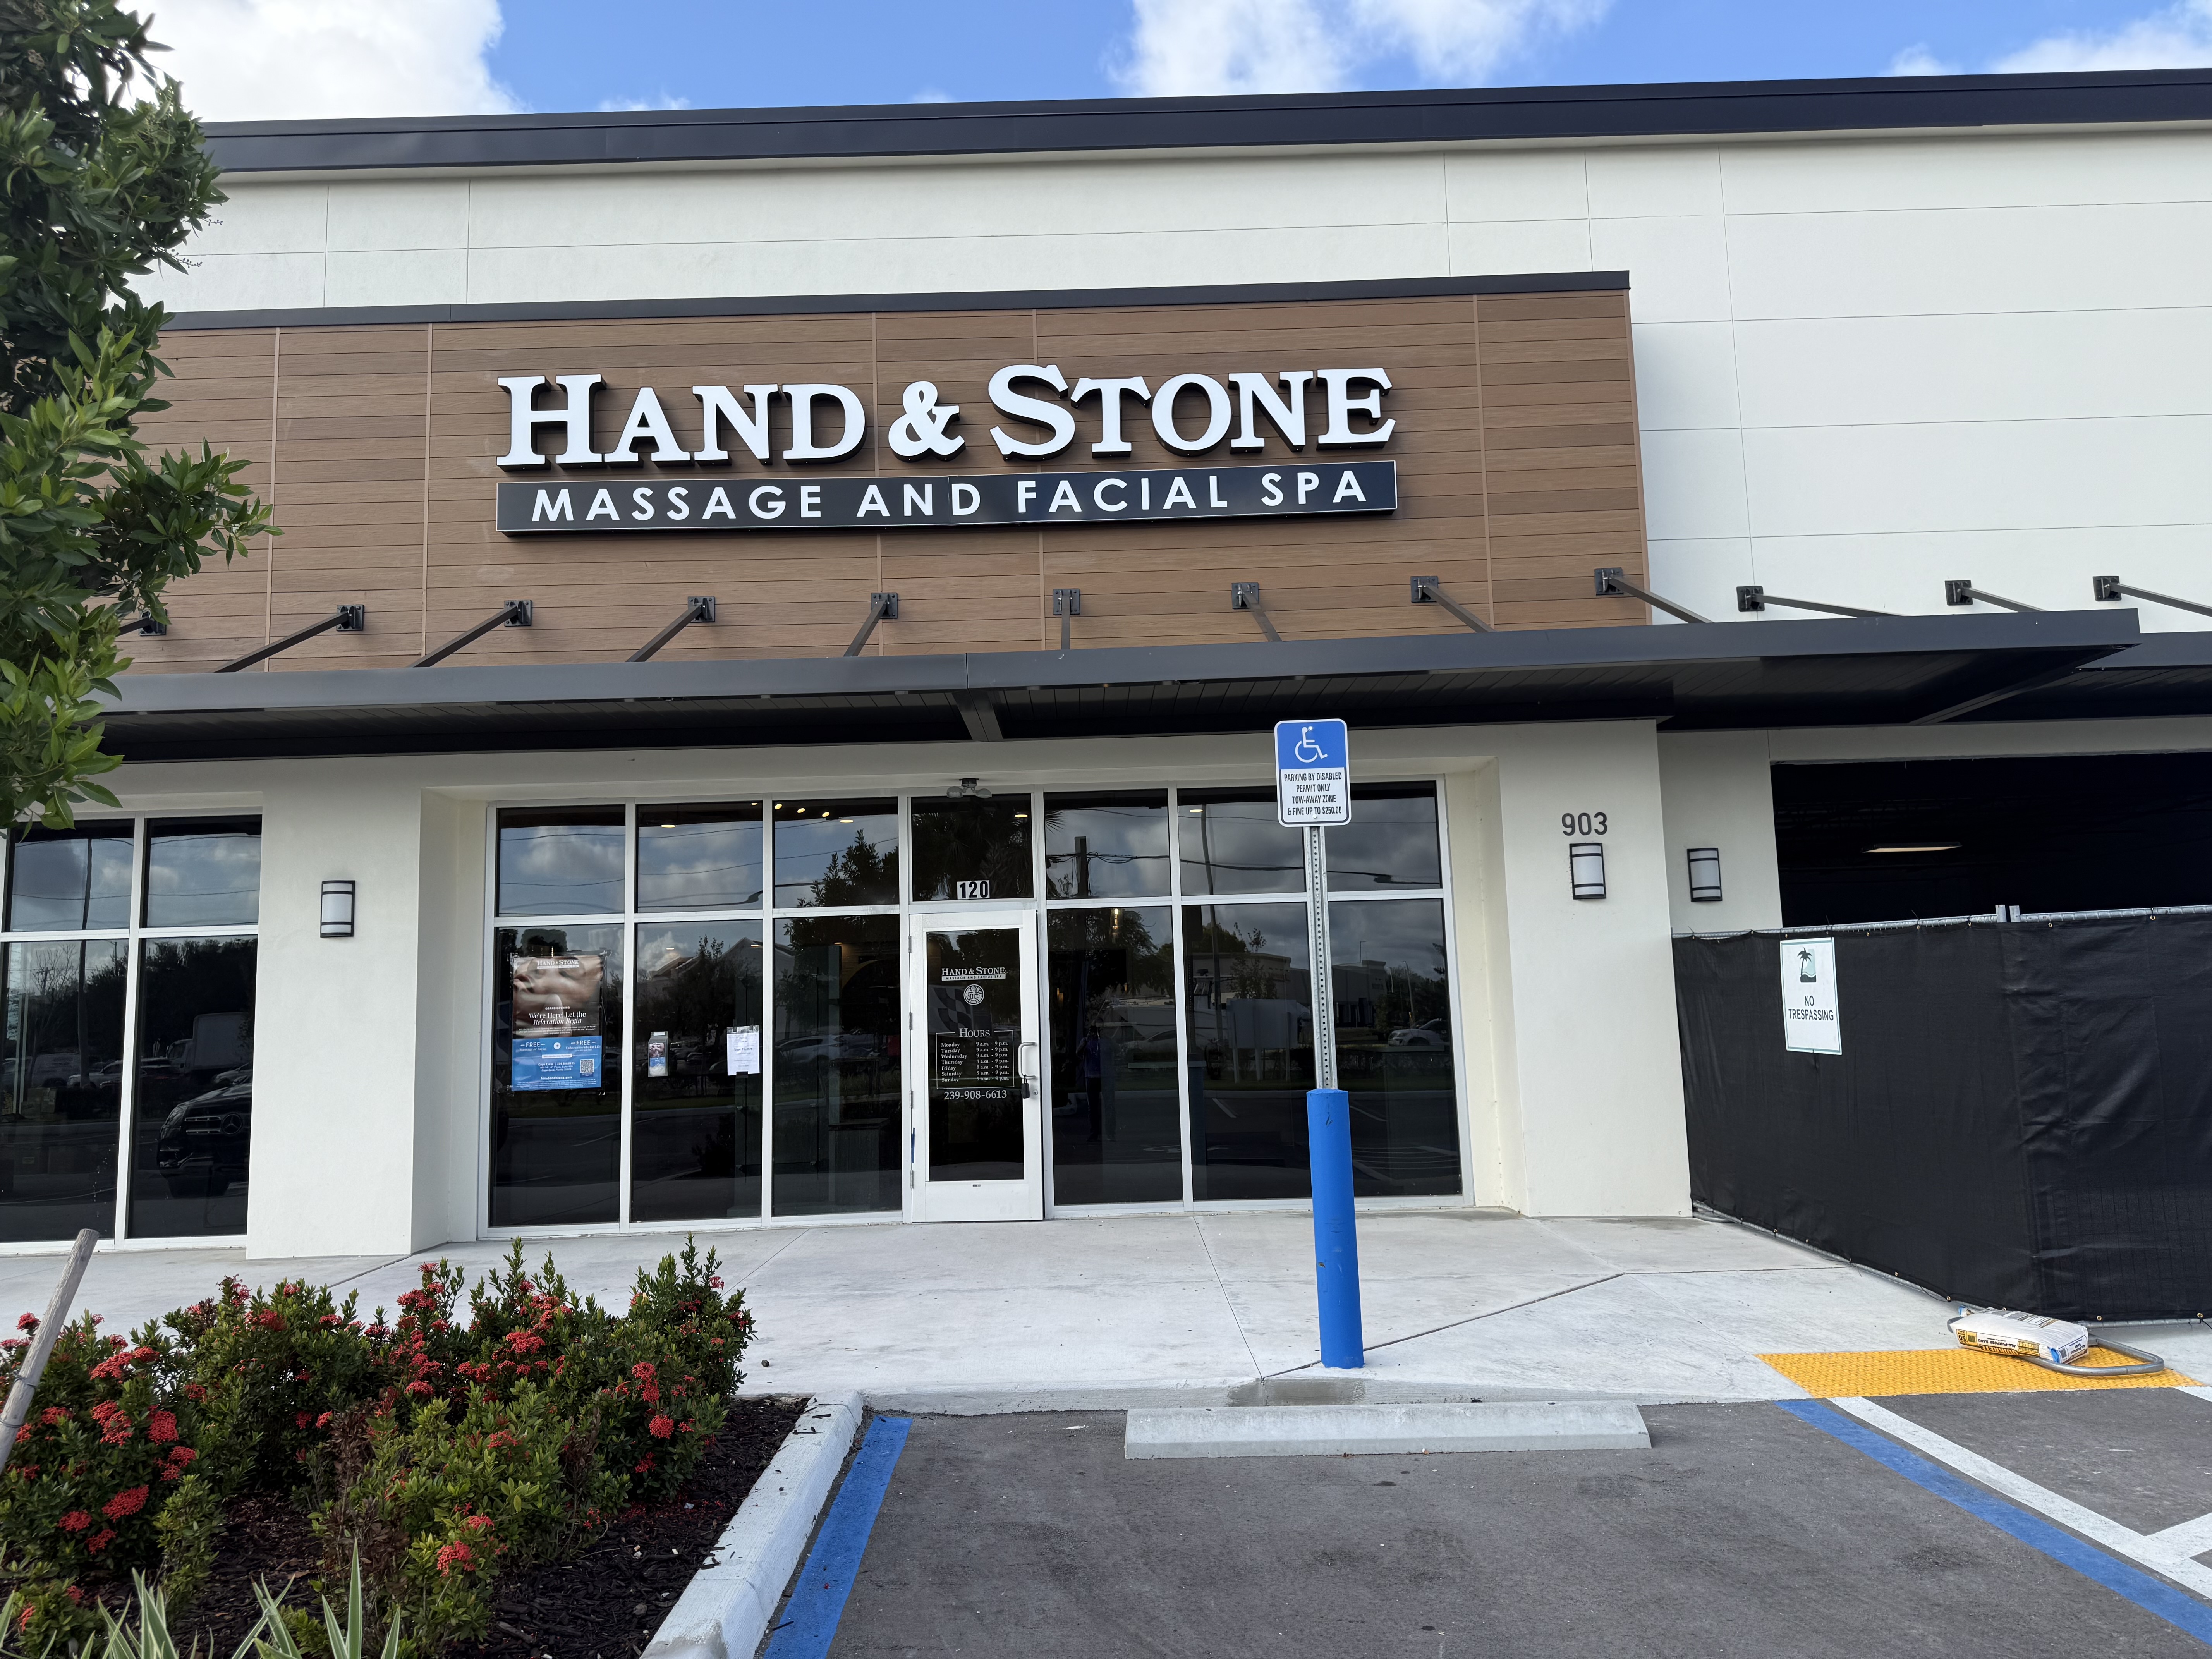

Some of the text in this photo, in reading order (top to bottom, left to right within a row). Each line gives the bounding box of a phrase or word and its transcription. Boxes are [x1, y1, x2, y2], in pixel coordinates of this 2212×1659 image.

[496, 364, 1396, 468] HAND & STONE
[532, 471, 1366, 521] MASSAGE AND FACIAL SPA
[1284, 773, 1307, 781] PARKING
[1317, 772, 1342, 780] DISABLED
[1296, 784, 1316, 792] PERMIT
[1292, 795, 1336, 804] TOW-AWAY ZONE
[1322, 806, 1342, 815] $250.00
[1561, 812, 1608, 836] 903
[959, 881, 988, 899] 120
[1805, 996, 1814, 1006] NO
[1788, 1009, 1834, 1021] TRESPASSING
[959, 1028, 990, 1037] HOURS
[944, 1090, 1007, 1100] 239-908-6613
